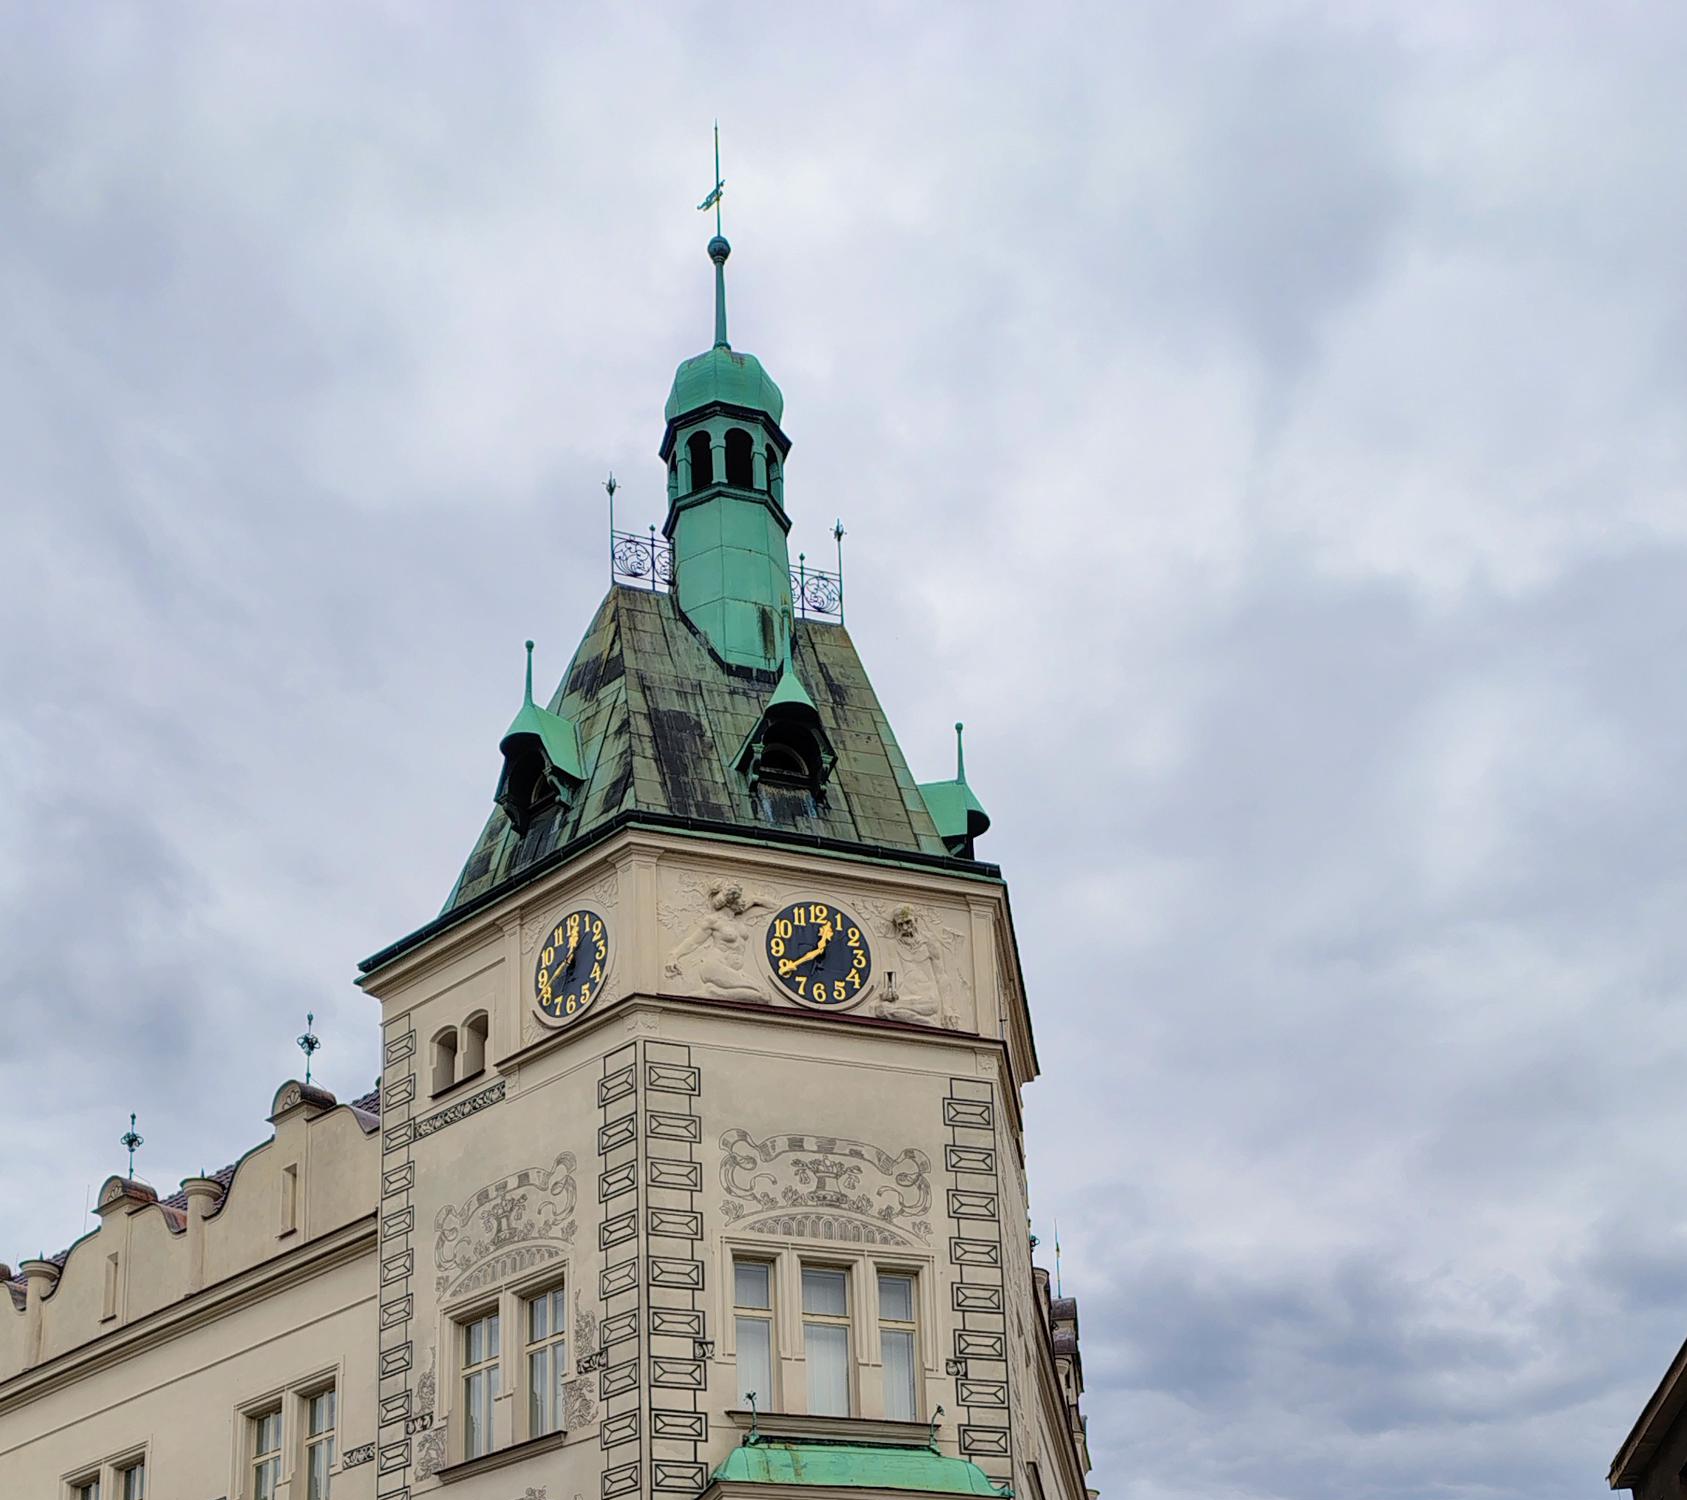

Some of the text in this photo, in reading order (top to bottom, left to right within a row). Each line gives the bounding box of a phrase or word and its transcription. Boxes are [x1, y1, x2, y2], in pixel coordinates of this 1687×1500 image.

[584, 914, 590, 932] 1
[793, 907, 806, 926] 11
[809, 905, 828, 924] 12
[835, 913, 843, 931] 1
[554, 926, 564, 948] 11
[592, 920, 602, 942] 2
[774, 919, 793, 938] 10
[847, 928, 860, 947] 2
[596, 939, 606, 960] 3
[771, 938, 785, 957] 9
[541, 946, 555, 969] 10
[853, 950, 866, 968] 3
[590, 962, 601, 983] 4
[778, 959, 793, 978] 8
[538, 969, 548, 989] 9
[795, 976, 807, 996] 7
[846, 968, 861, 989] 4
[580, 982, 590, 1004] 5
[813, 983, 826, 1002] 6
[833, 981, 846, 1000] 5
[554, 995, 563, 1016] 7
[566, 994, 576, 1014] 6
